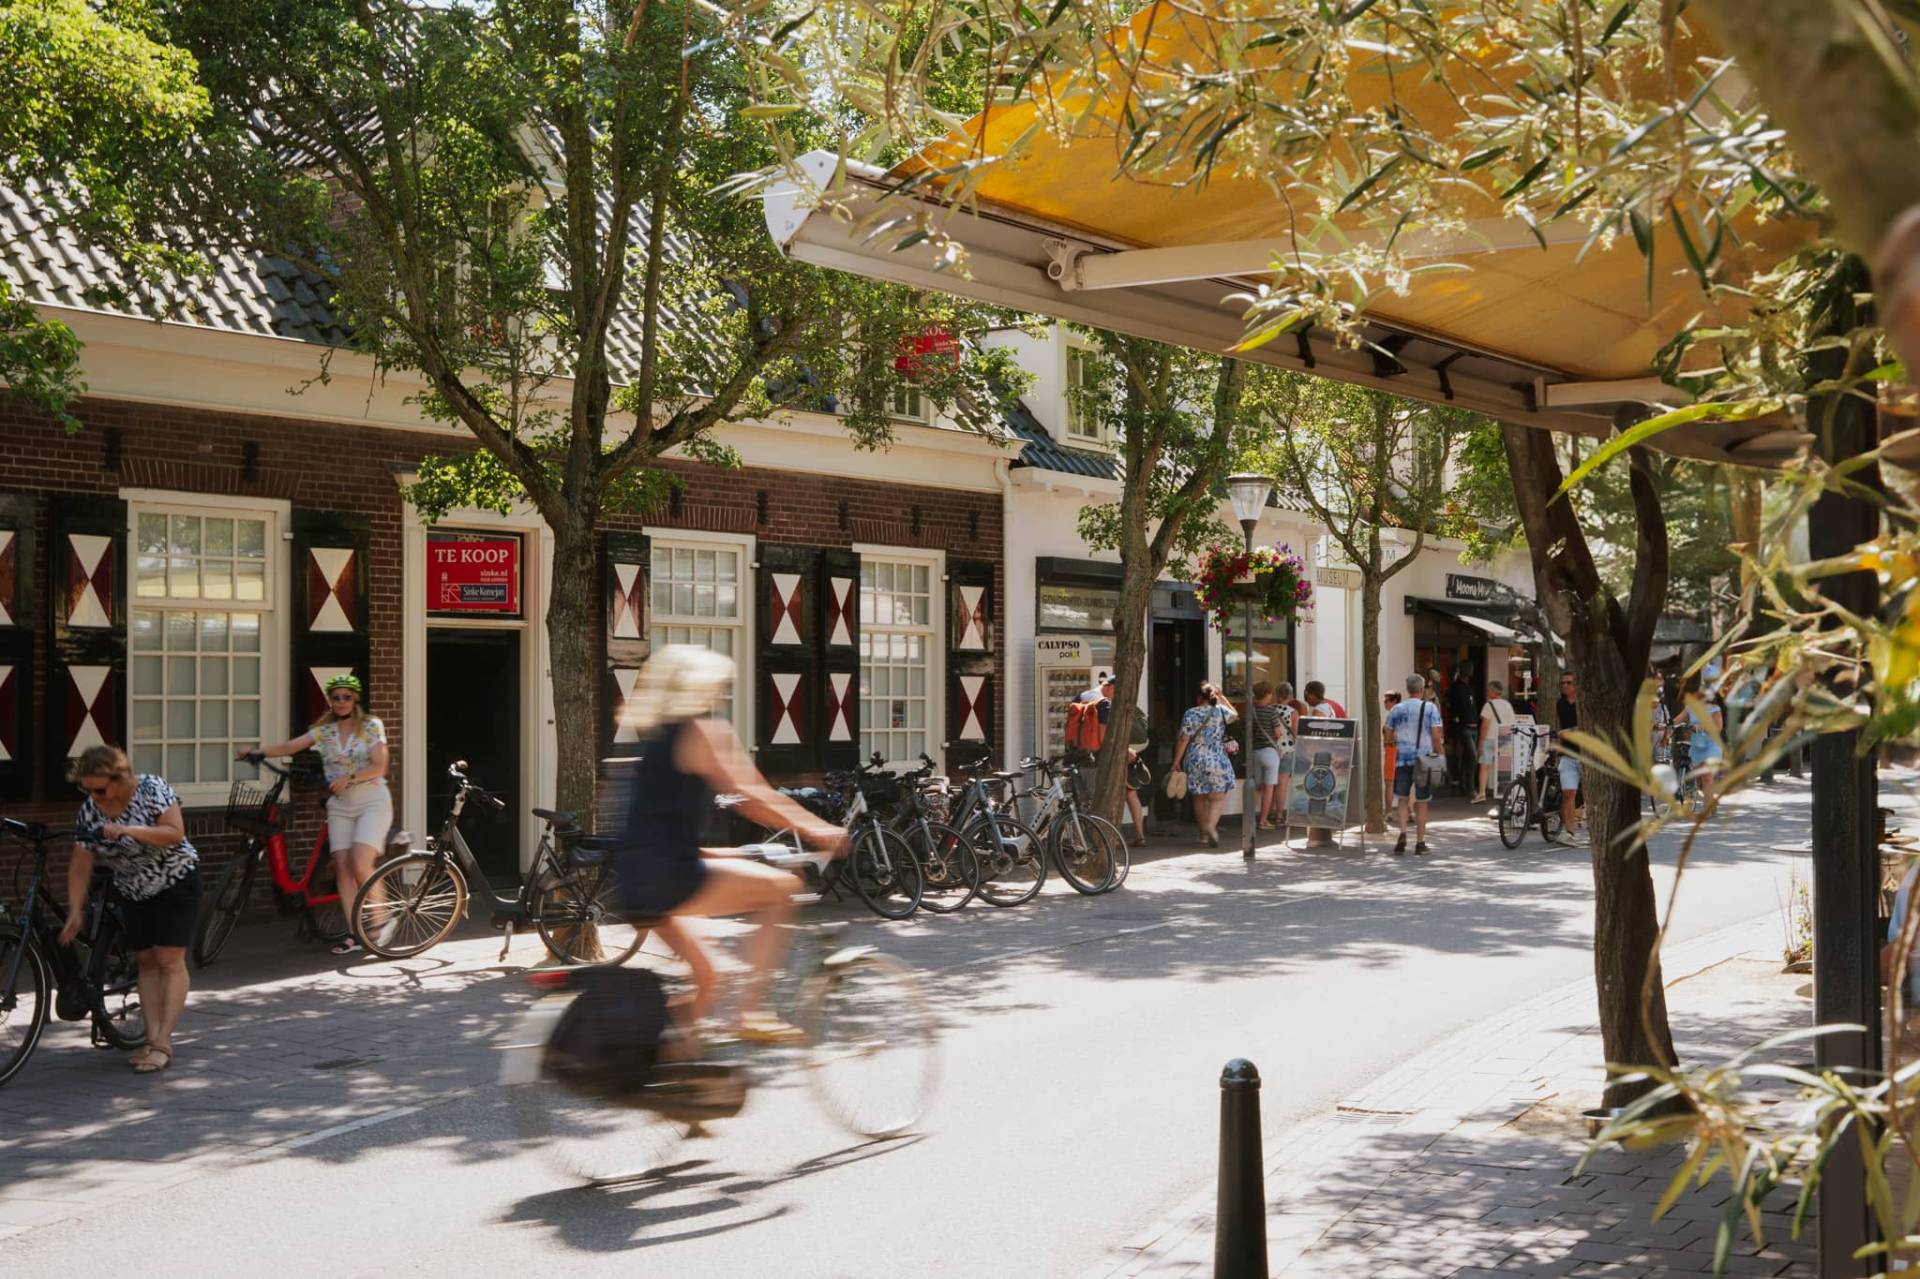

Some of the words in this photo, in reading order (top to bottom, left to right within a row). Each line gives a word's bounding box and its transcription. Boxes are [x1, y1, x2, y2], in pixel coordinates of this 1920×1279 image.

[435, 549, 457, 563] TE
[461, 549, 509, 563] KOOP
[1317, 569, 1349, 585] MUSEUM
[1038, 641, 1080, 649] CALYPSO
